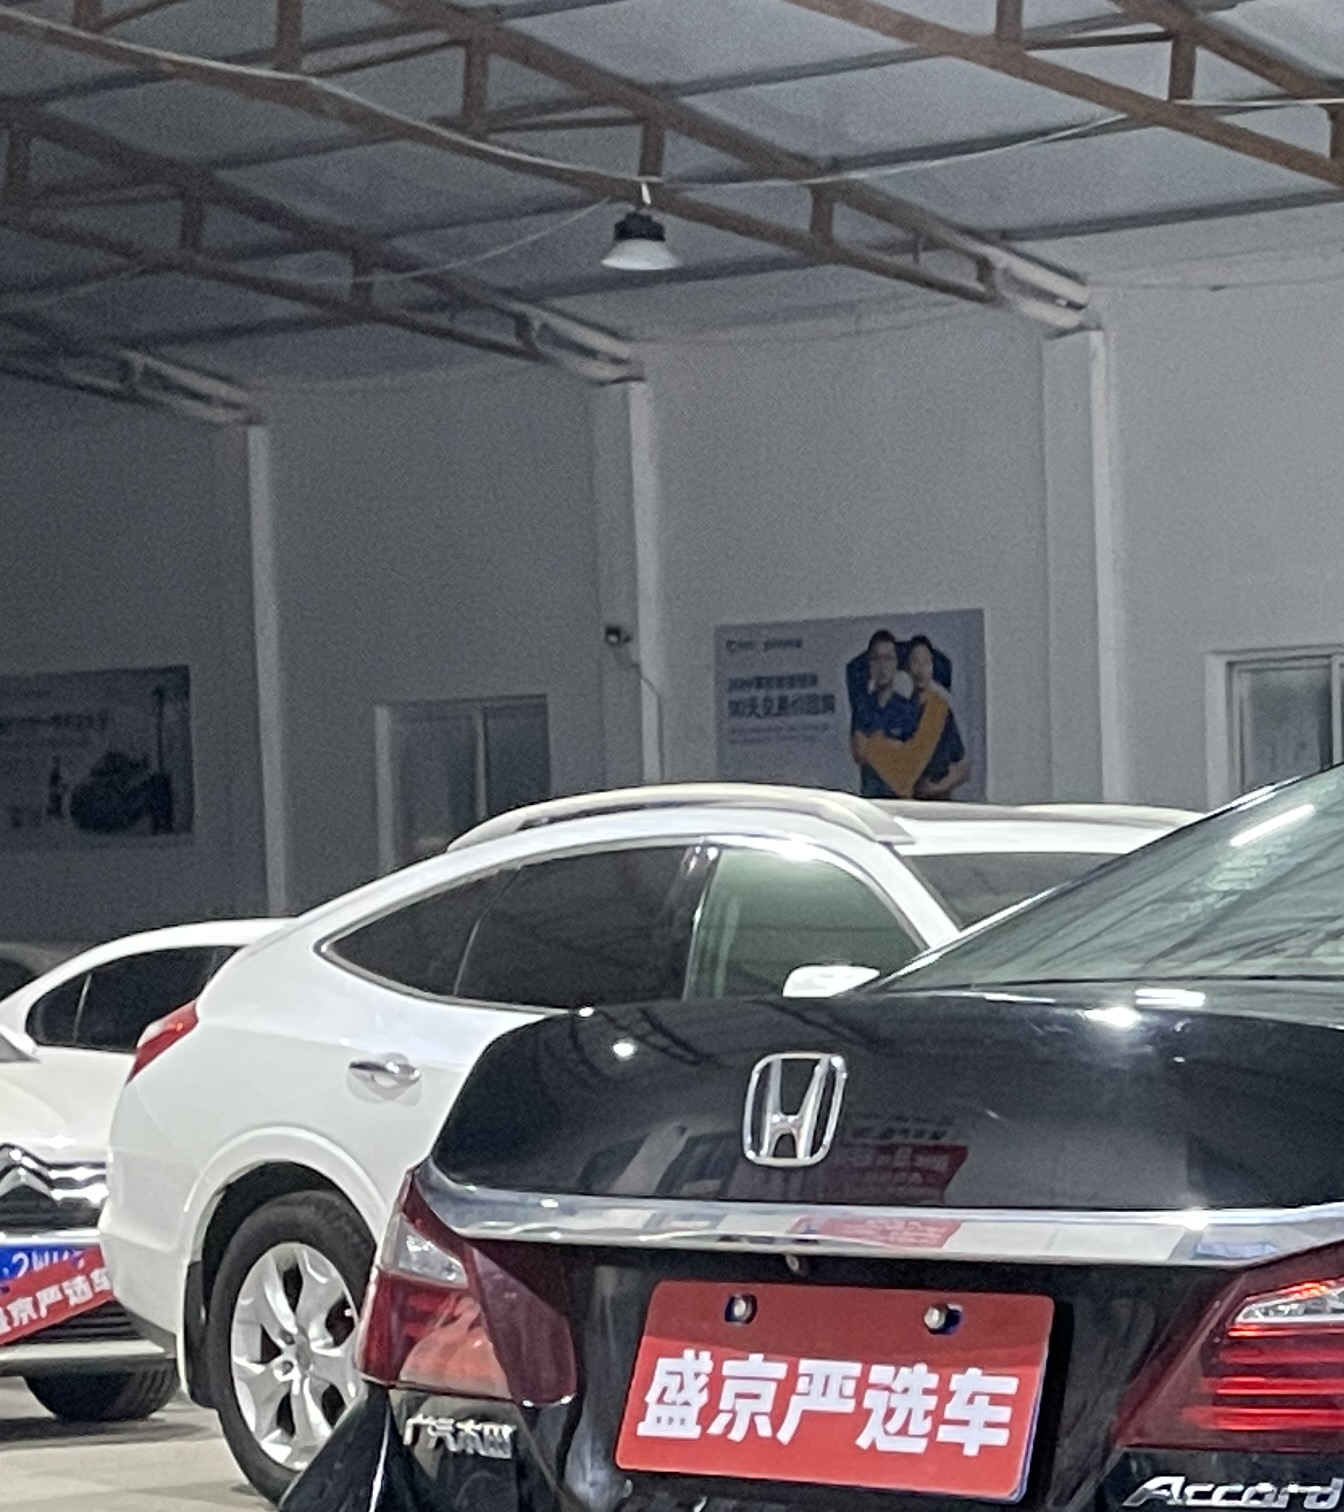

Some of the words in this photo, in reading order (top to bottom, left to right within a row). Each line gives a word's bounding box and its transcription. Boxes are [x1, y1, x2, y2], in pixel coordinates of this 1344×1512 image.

[636, 1348, 1019, 1457] 盛京严选车
